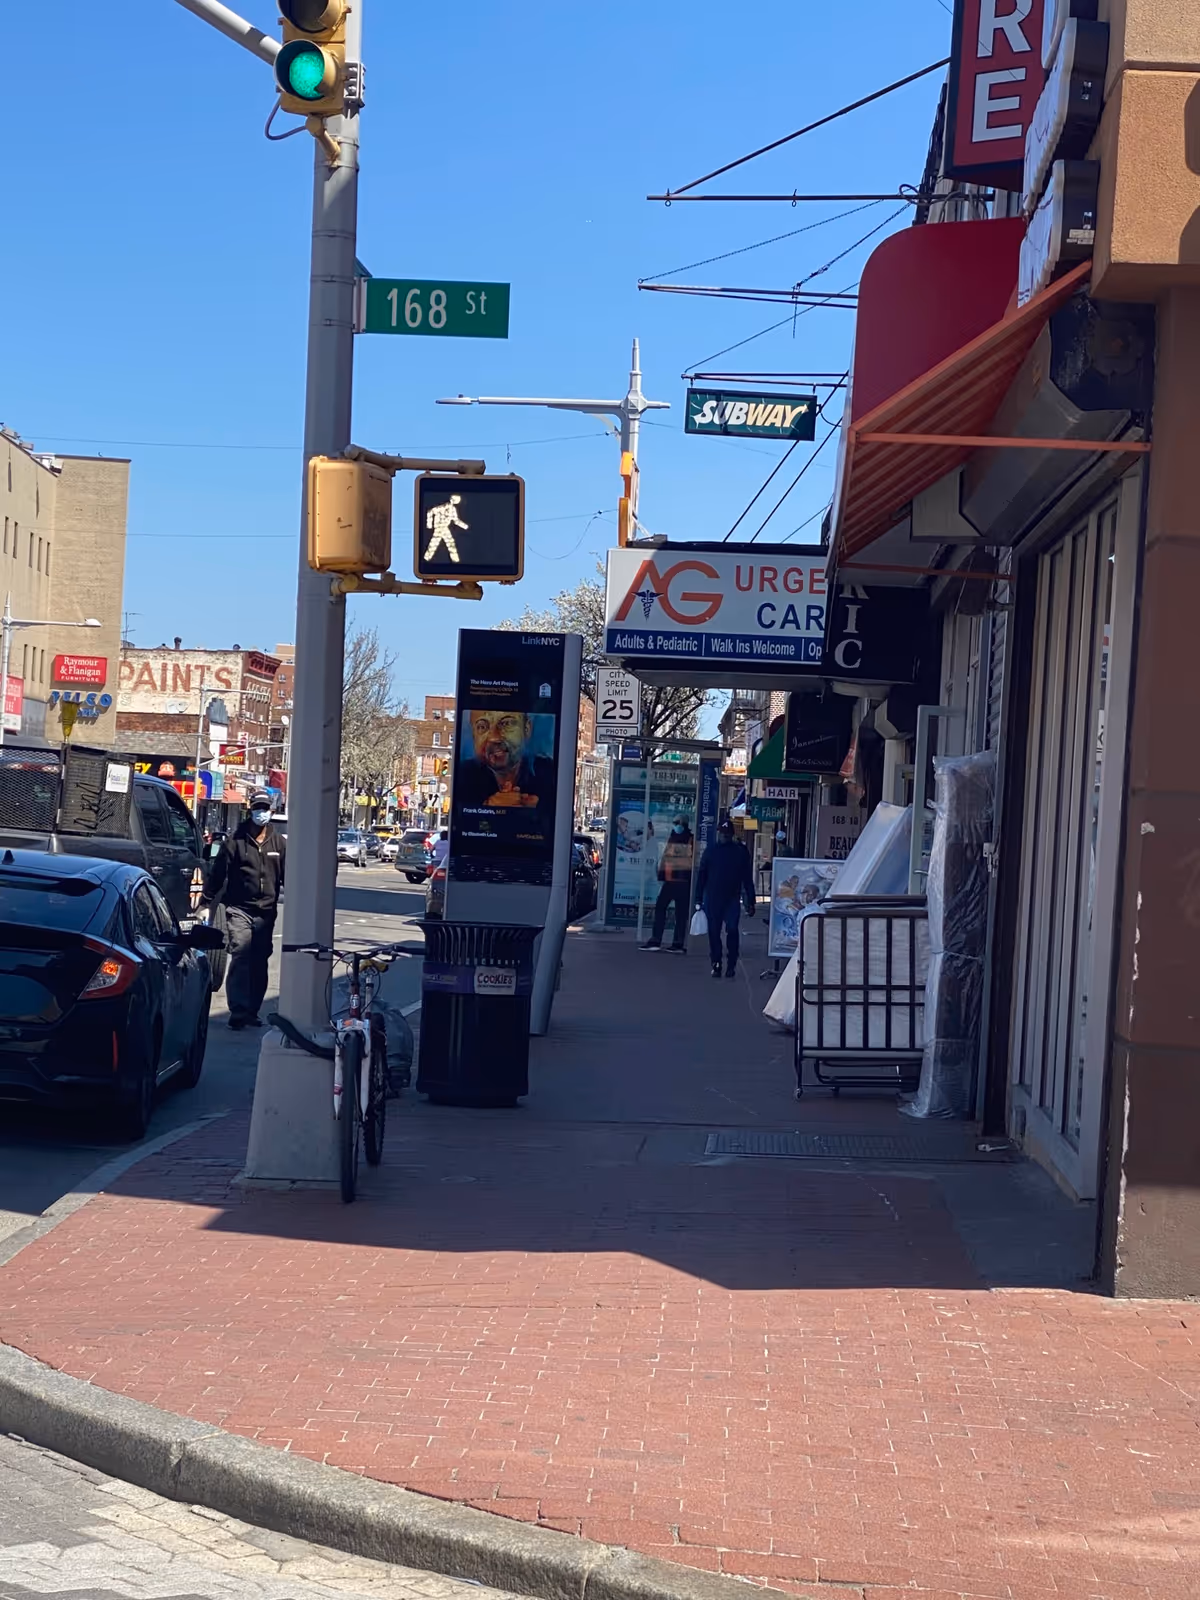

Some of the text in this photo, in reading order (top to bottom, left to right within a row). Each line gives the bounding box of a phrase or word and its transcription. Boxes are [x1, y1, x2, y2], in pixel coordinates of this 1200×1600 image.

[387, 288, 487, 328] 168 St
[693, 400, 809, 428] SUBWAY
[614, 559, 724, 625] AG
[756, 602, 825, 631] CAR
[521, 636, 560, 646] LinkNYC
[614, 634, 645, 650] Adults
[647, 635, 653, 650] &
[656, 635, 698, 651] Pediatric
[711, 639, 734, 653] Walk
[736, 640, 750, 653] Ins
[752, 640, 795, 655] Welcome
[60, 665, 101, 676] & Flanigan
[63, 657, 99, 666] Raymour
[118, 660, 232, 693] PAINTS
[605, 680, 631, 688] SPEED
[602, 699, 633, 720] 25
[702, 774, 712, 813] Jamaica
[767, 788, 796, 798] HAIR
